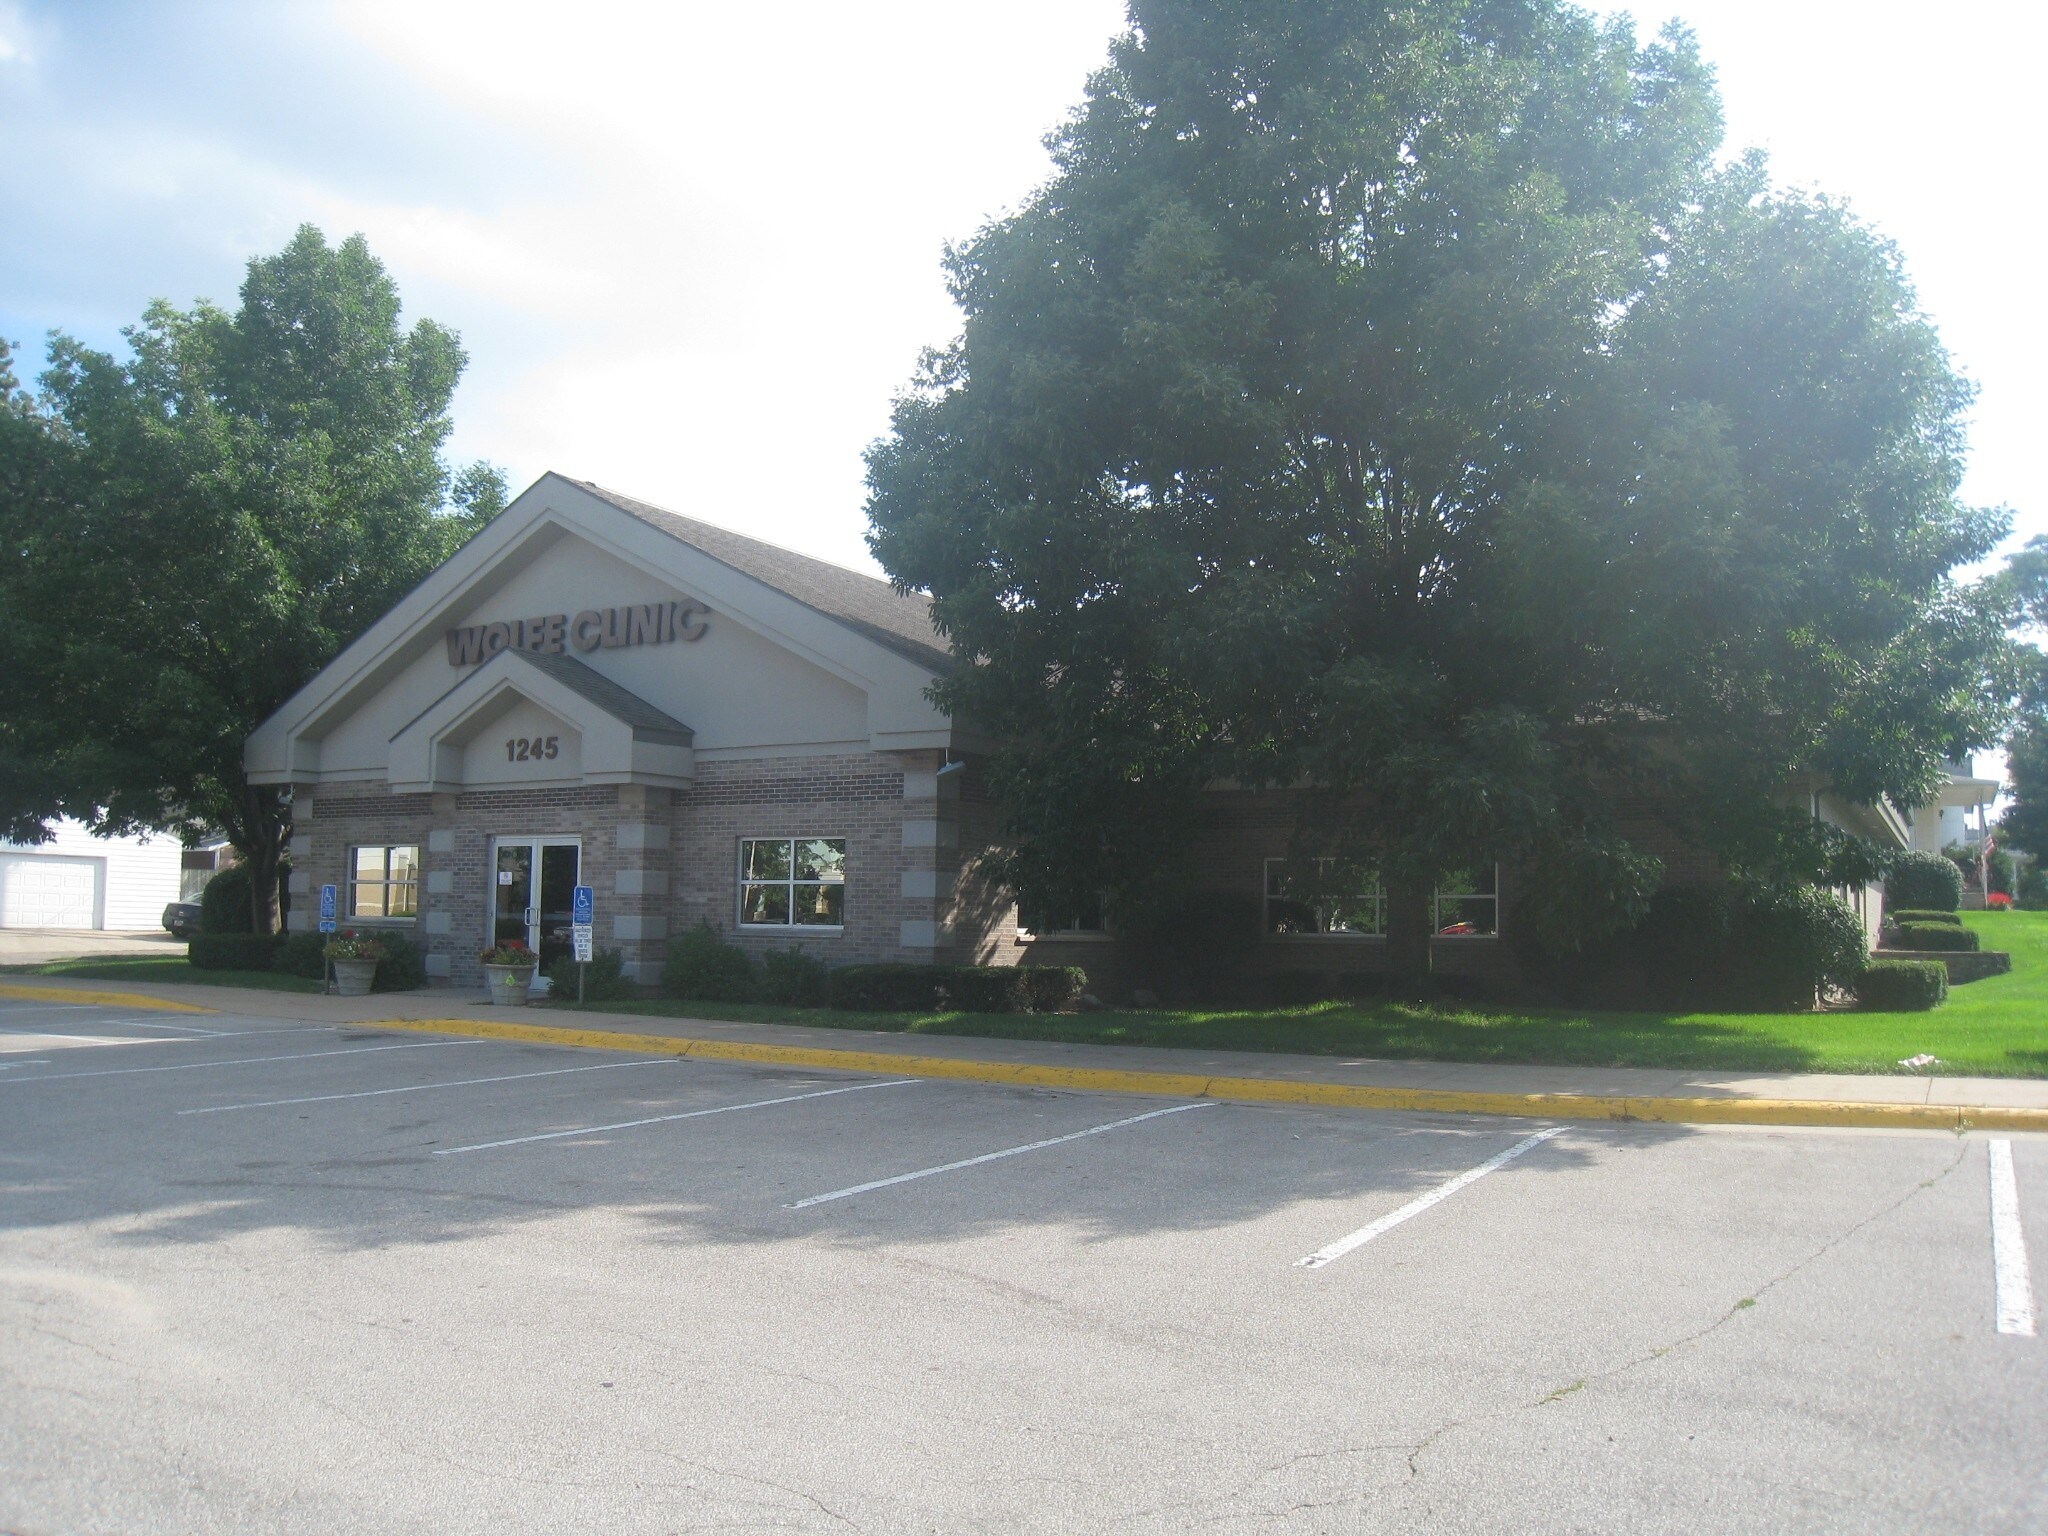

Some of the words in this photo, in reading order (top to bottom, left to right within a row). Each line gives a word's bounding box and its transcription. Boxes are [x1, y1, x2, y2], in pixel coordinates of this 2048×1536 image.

[446, 614, 567, 666] WOLFE
[571, 599, 711, 652] CLINIC
[506, 736, 559, 762] 1245
